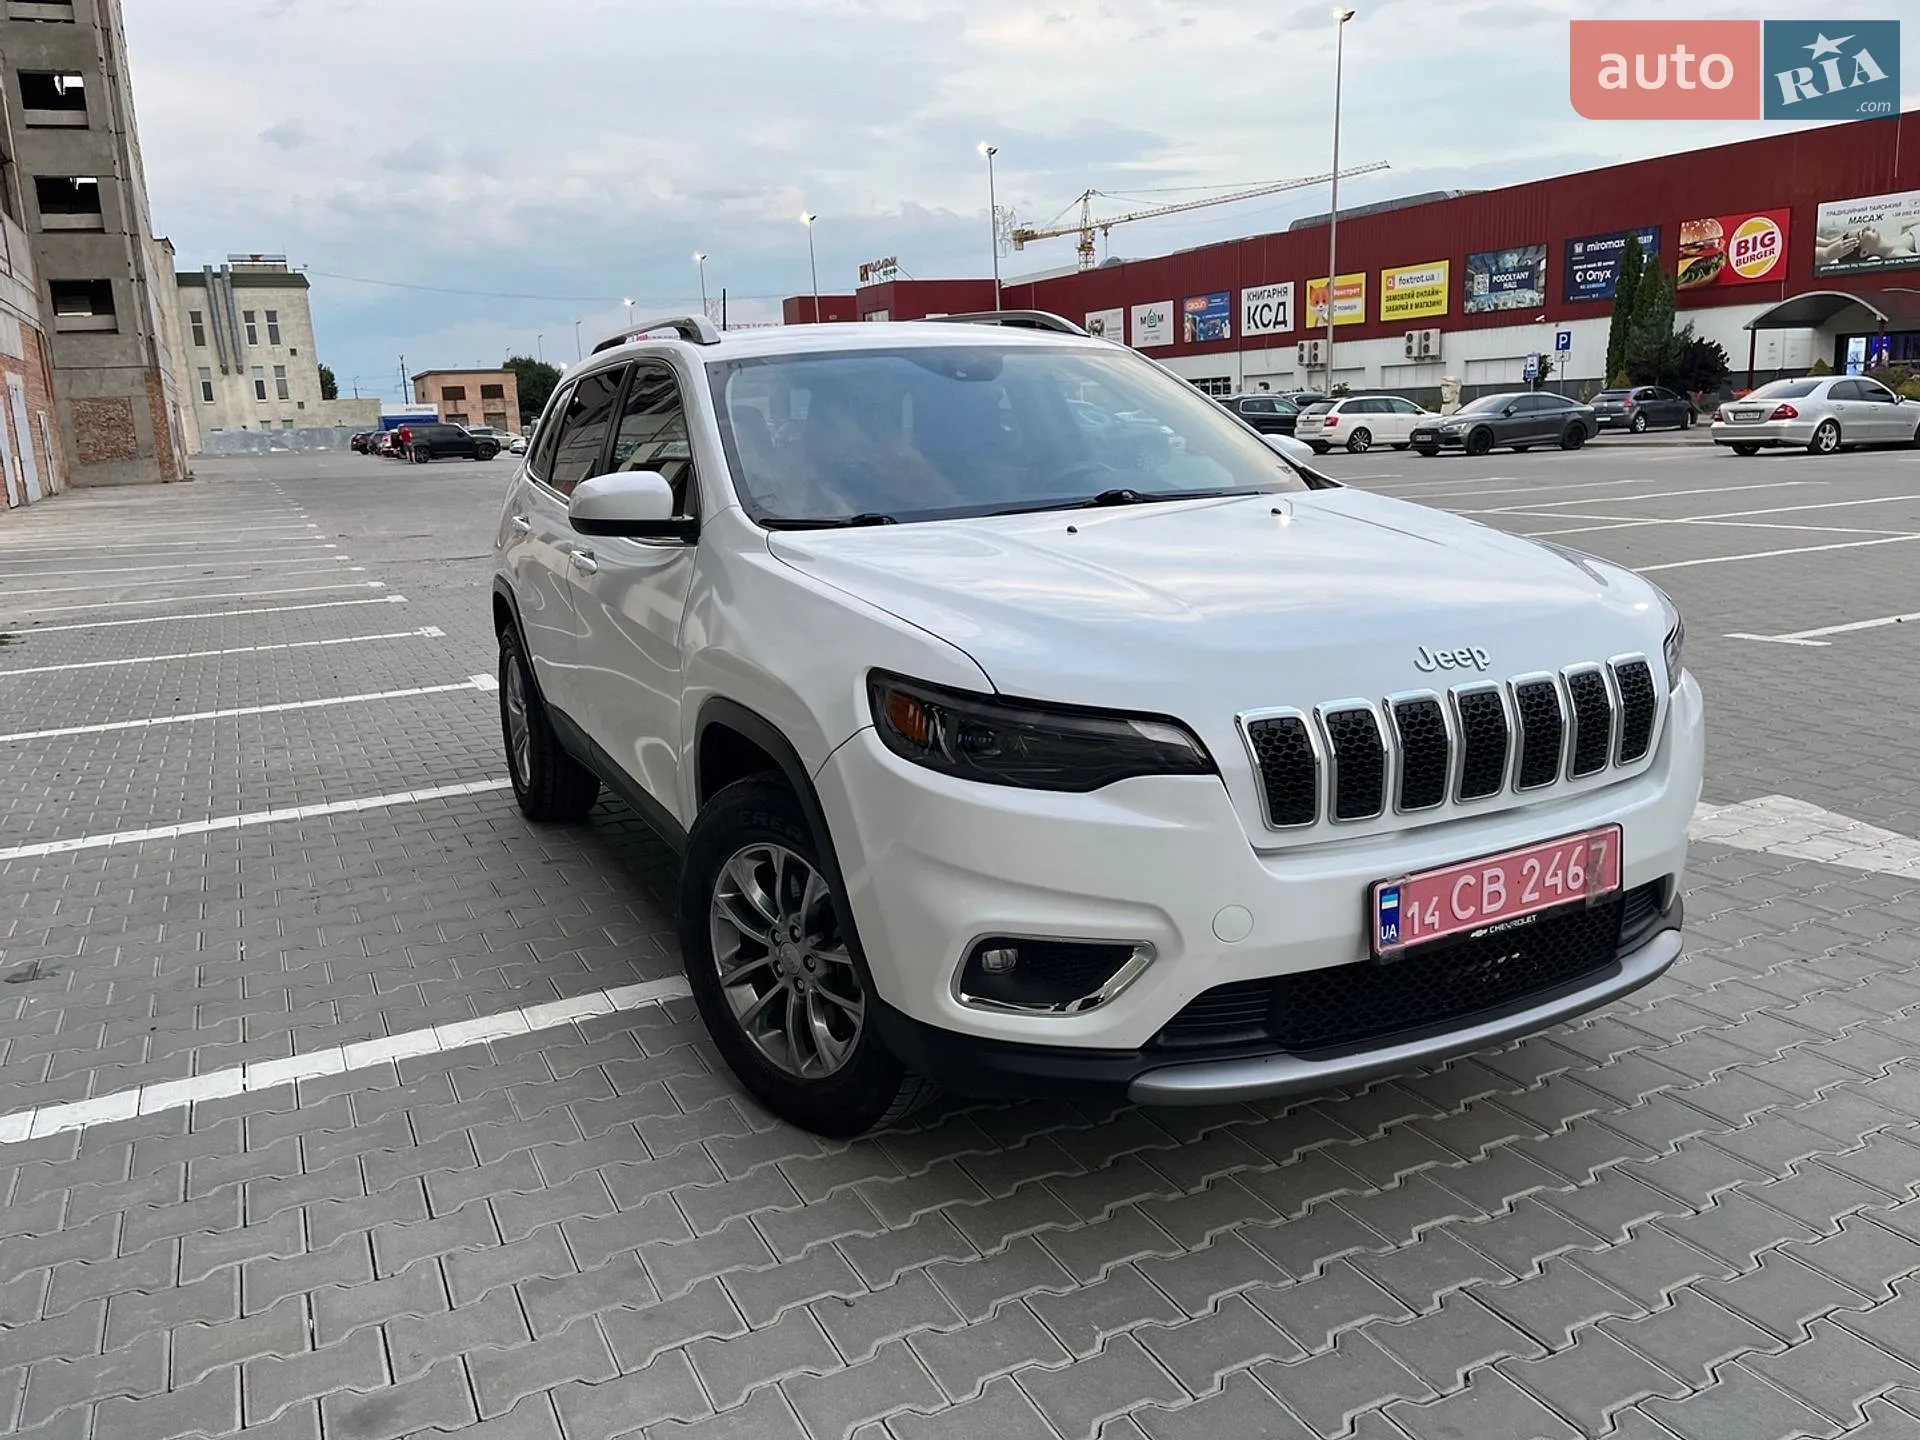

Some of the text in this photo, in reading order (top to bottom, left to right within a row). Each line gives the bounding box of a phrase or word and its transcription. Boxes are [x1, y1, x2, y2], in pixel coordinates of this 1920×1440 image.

[1848, 213, 1885, 225] МАСАЖ
[1586, 239, 1626, 252] miromax
[1736, 230, 1776, 257] BIG
[1735, 247, 1775, 267] BURGER
[1398, 273, 1435, 286] foxtrot.ua
[1492, 271, 1530, 283] PODOLYANY
[1586, 269, 1612, 282] Onyx
[1247, 286, 1288, 301] КНИГАРНЯ
[1558, 333, 1568, 349] P
[1413, 645, 1491, 673] Jeep
[1406, 895, 1440, 935] 14
[1451, 867, 1507, 920] CB
[1381, 923, 1398, 940] UA
[1489, 914, 1537, 933] CHEVROLET
